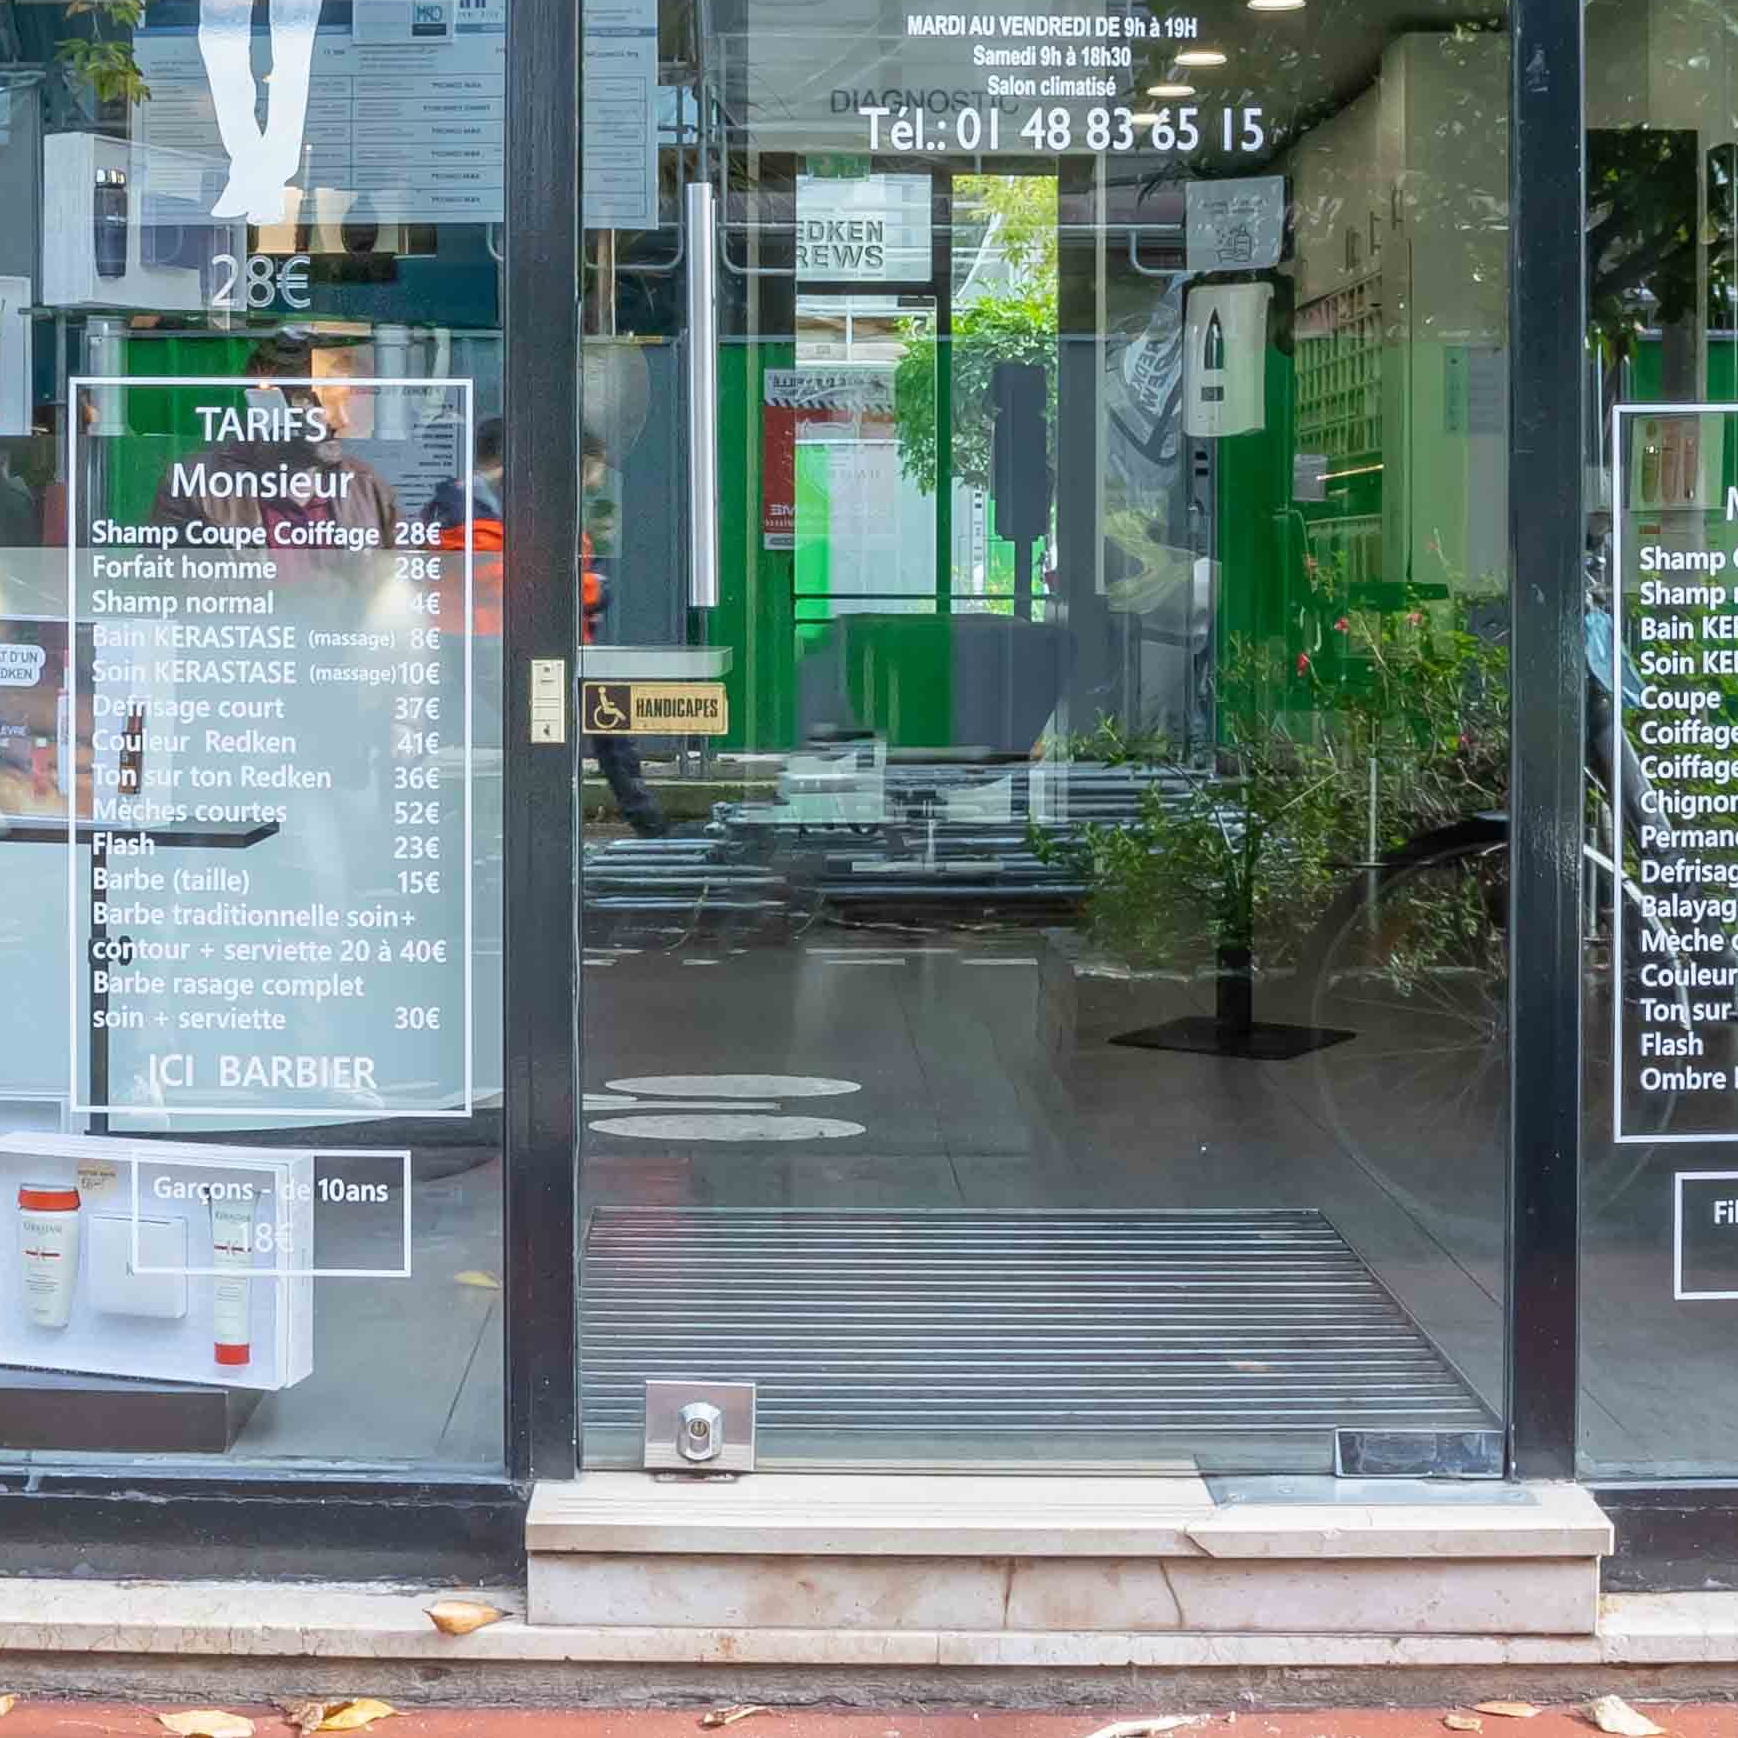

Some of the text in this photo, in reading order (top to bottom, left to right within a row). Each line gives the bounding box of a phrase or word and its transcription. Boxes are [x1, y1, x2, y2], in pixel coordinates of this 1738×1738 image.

[907, 14, 1198, 39] MARDI AU VENDREDI DE 9h à 19H
[973, 44, 1132, 67] Samedi 9h à 18h30
[987, 74, 1116, 96] Salon climatisé
[956, 107, 999, 151] 01
[1021, 108, 1072, 151] 48
[1085, 109, 1134, 151] 83
[1151, 108, 1199, 151] 65
[1223, 108, 1263, 151] 15
[212, 254, 311, 309] 28€
[195, 407, 327, 444] TARIFS
[171, 462, 355, 499] Monsieur
[92, 520, 442, 546] Shamp Coupe Coiffage 28€
[93, 555, 442, 581] Forfait homme 28€
[1639, 546, 1726, 574] Shamp
[1639, 581, 1726, 608] Shamp
[1640, 615, 1695, 640] Bain
[10, 650, 38, 663] D'UN
[1640, 650, 1695, 675] Soin
[218, 697, 286, 719] court
[394, 696, 440, 721] 37€
[636, 697, 719, 718] HANDICAPES
[1639, 685, 1721, 712] Coupe
[92, 867, 440, 895] Barbe (taille) 15€
[1640, 929, 1724, 953] Mèche
[1640, 1031, 1704, 1056] Flash
[149, 1052, 378, 1090] ICI BARBIER
[1640, 1066, 1727, 1091] Ombre
[153, 1175, 253, 1205] Garçons
[284, 1176, 311, 1201] de
[317, 1177, 389, 1202] 10ans
